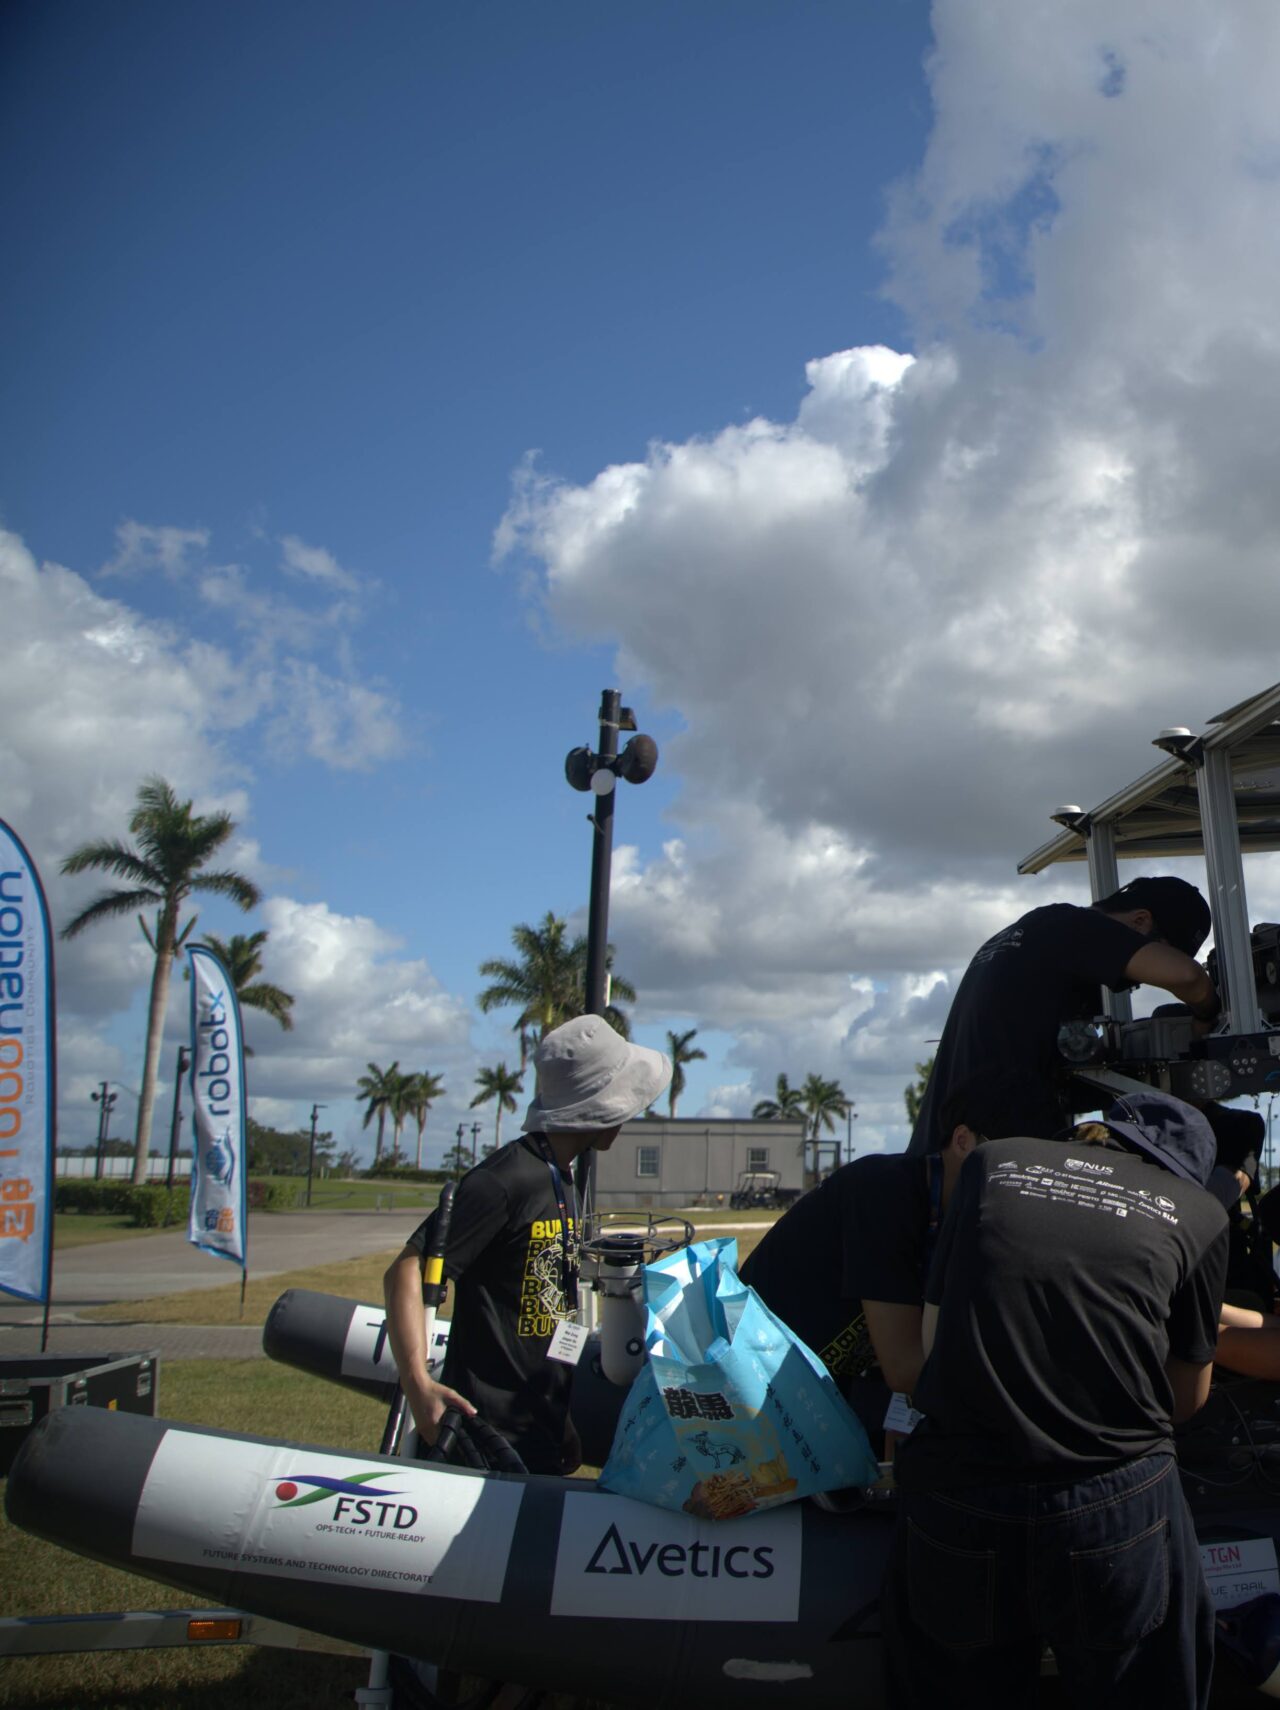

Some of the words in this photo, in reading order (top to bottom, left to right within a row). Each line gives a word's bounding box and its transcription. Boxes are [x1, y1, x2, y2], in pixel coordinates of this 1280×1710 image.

[1083, 1162, 1114, 1174] NUS
[333, 1497, 418, 1530] FSTD
[316, 1523, 356, 1535] OPS-TECH
[364, 1529, 426, 1543] FUTURE-READY
[1208, 1546, 1241, 1565] TGN
[203, 1549, 240, 1561] FUTURE
[240, 1553, 283, 1567] SYSTEMS
[284, 1559, 306, 1569] AND
[308, 1561, 371, 1577] TECHNOLOGY
[370, 1568, 434, 1584] DIRECTORATE
